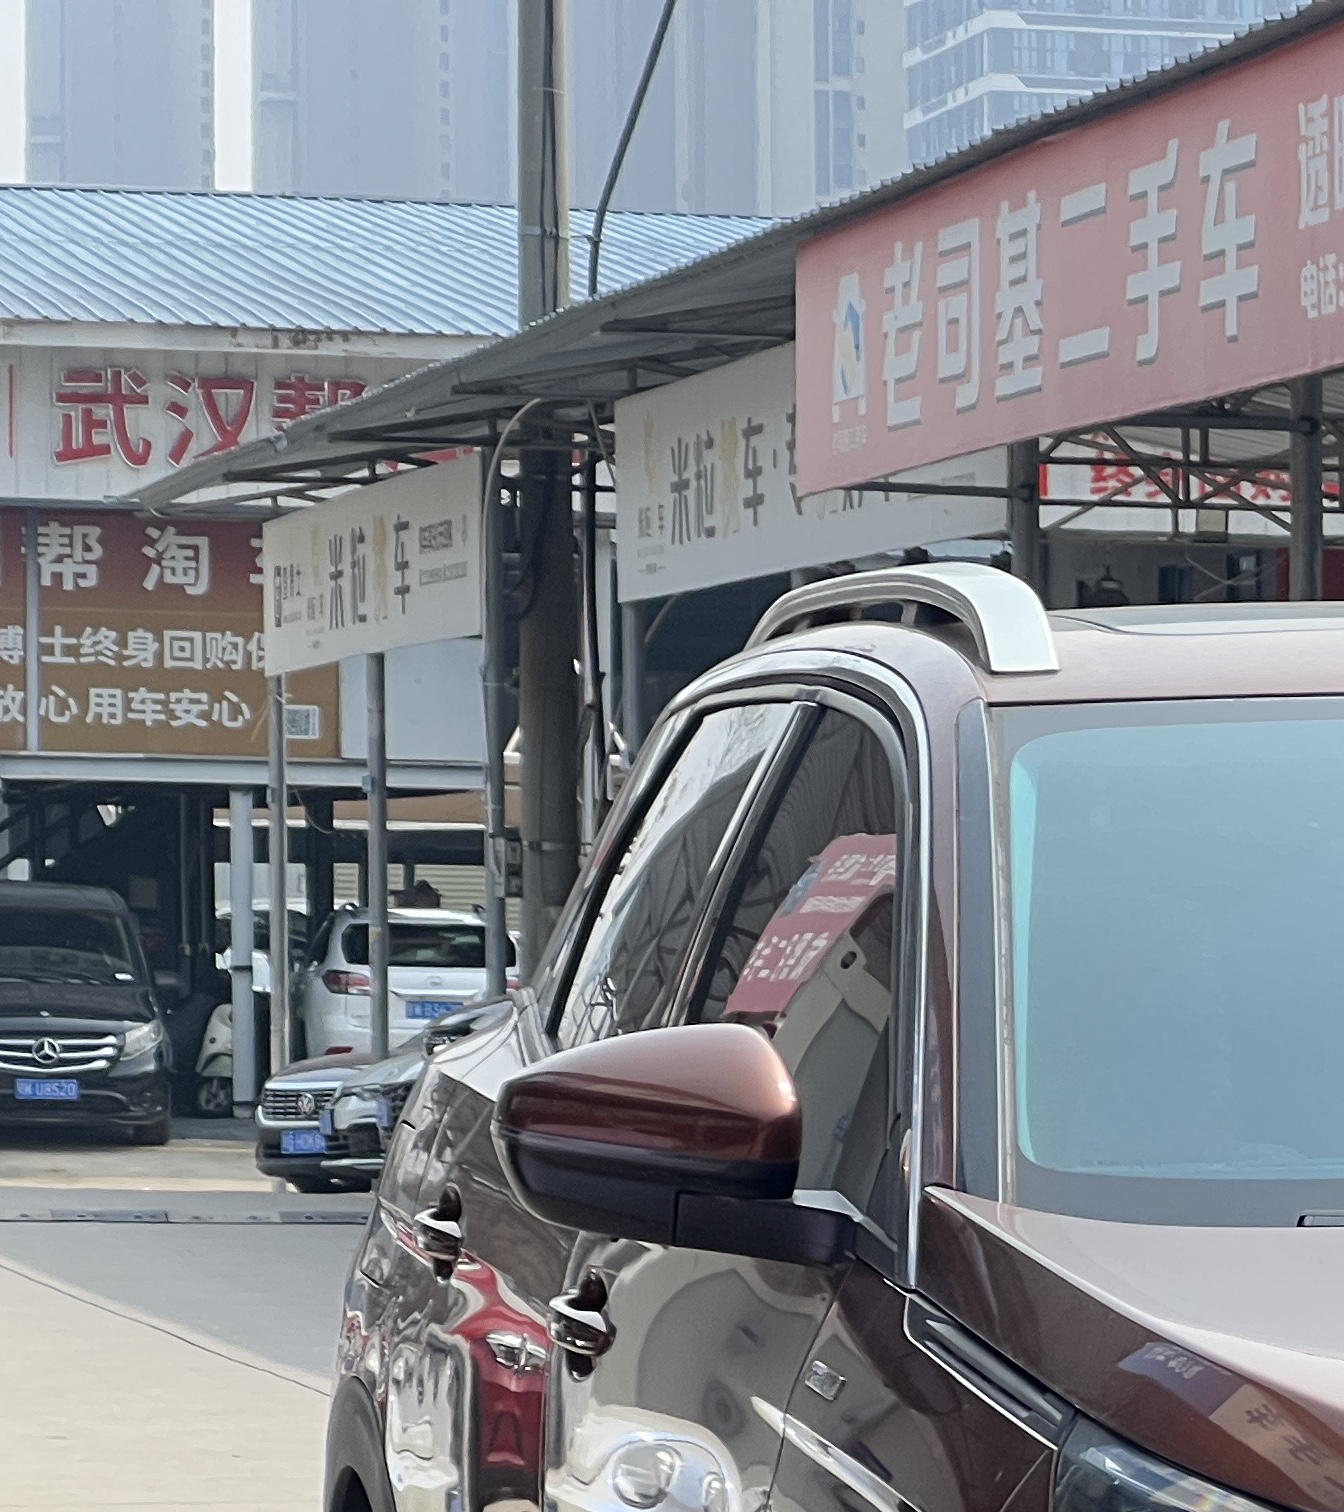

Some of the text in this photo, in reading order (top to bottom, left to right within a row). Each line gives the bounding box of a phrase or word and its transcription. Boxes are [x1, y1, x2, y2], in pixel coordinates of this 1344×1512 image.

[882, 118, 1259, 431] 老司基二手车
[20, 520, 264, 596] 帮淘
